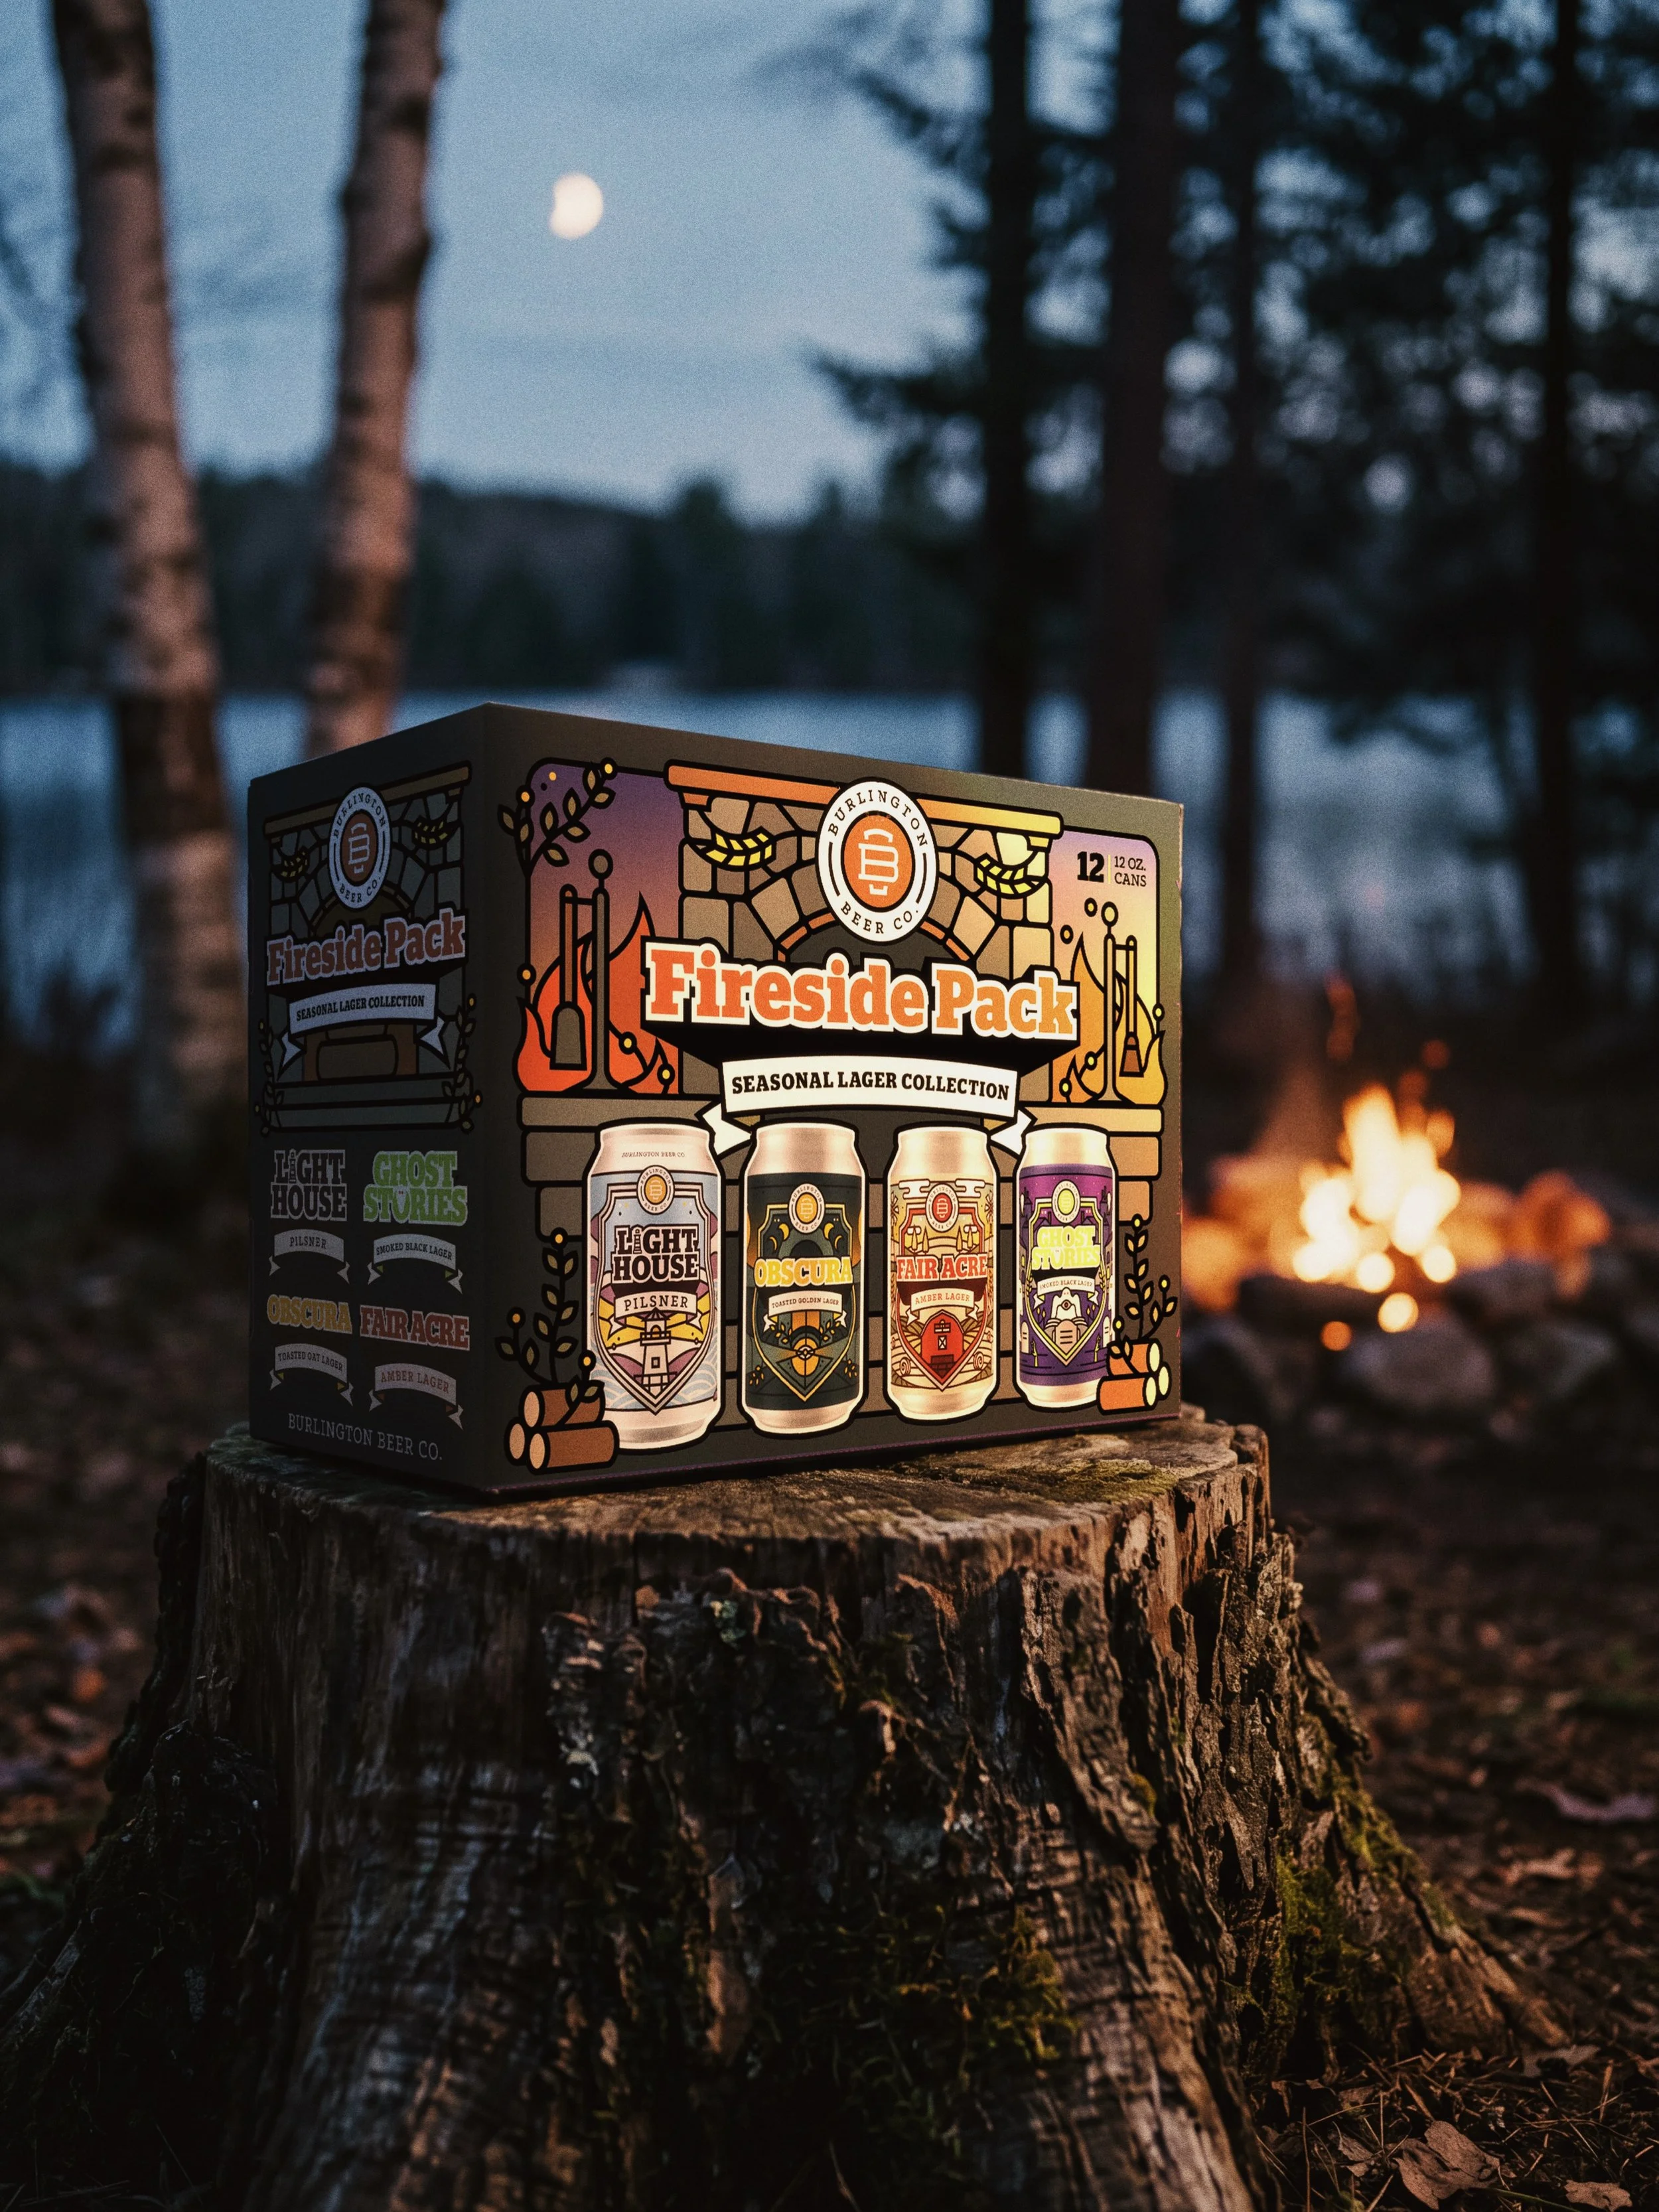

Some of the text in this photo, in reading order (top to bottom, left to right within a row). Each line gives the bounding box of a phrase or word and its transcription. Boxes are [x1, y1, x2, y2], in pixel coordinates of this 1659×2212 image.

[334, 792, 386, 838] BURLINGTON
[828, 790, 928, 847] BURLINGTON
[1077, 851, 1104, 883] 12
[1114, 855, 1146, 871] 12 OZ.
[340, 877, 382, 903] BEER CO.
[1114, 872, 1147, 887] CANS
[841, 902, 918, 934] BEER CO.
[267, 909, 466, 986] Fireside Pack
[645, 942, 1078, 1041] Fireside Pack
[296, 995, 425, 1021] SEASONAL LAGER COLLECTION
[731, 1071, 1010, 1101] SEASONAL LAGER COLLECTION
[274, 1148, 345, 1185] LIGHT
[372, 1150, 458, 1187] GHOST
[270, 1183, 347, 1221] HOUSE
[363, 1185, 468, 1226] STORIES
[289, 1236, 326, 1250] PILSNER
[376, 1242, 453, 1261] SMOKED BLACK LAGER
[614, 1224, 699, 1255] LIGHT
[1037, 1225, 1096, 1248] GHOST
[613, 1254, 699, 1284] HOUSE
[755, 1256, 853, 1288] OBSCURA
[897, 1254, 987, 1282] FAIR ACRE
[1031, 1244, 1100, 1270] STORIES
[624, 1295, 688, 1311] PILSNER
[772, 1299, 796, 1308] TOASTED
[915, 1292, 970, 1304] AMBER LAGER
[267, 1293, 352, 1334] OBSCURA
[360, 1304, 470, 1351] FAIR ACRE
[278, 1351, 343, 1371] TOASTED OAT LAGER
[381, 1371, 449, 1393] AMBER LAGER
[288, 1413, 443, 1460] BURLINGTON BEER CO.
